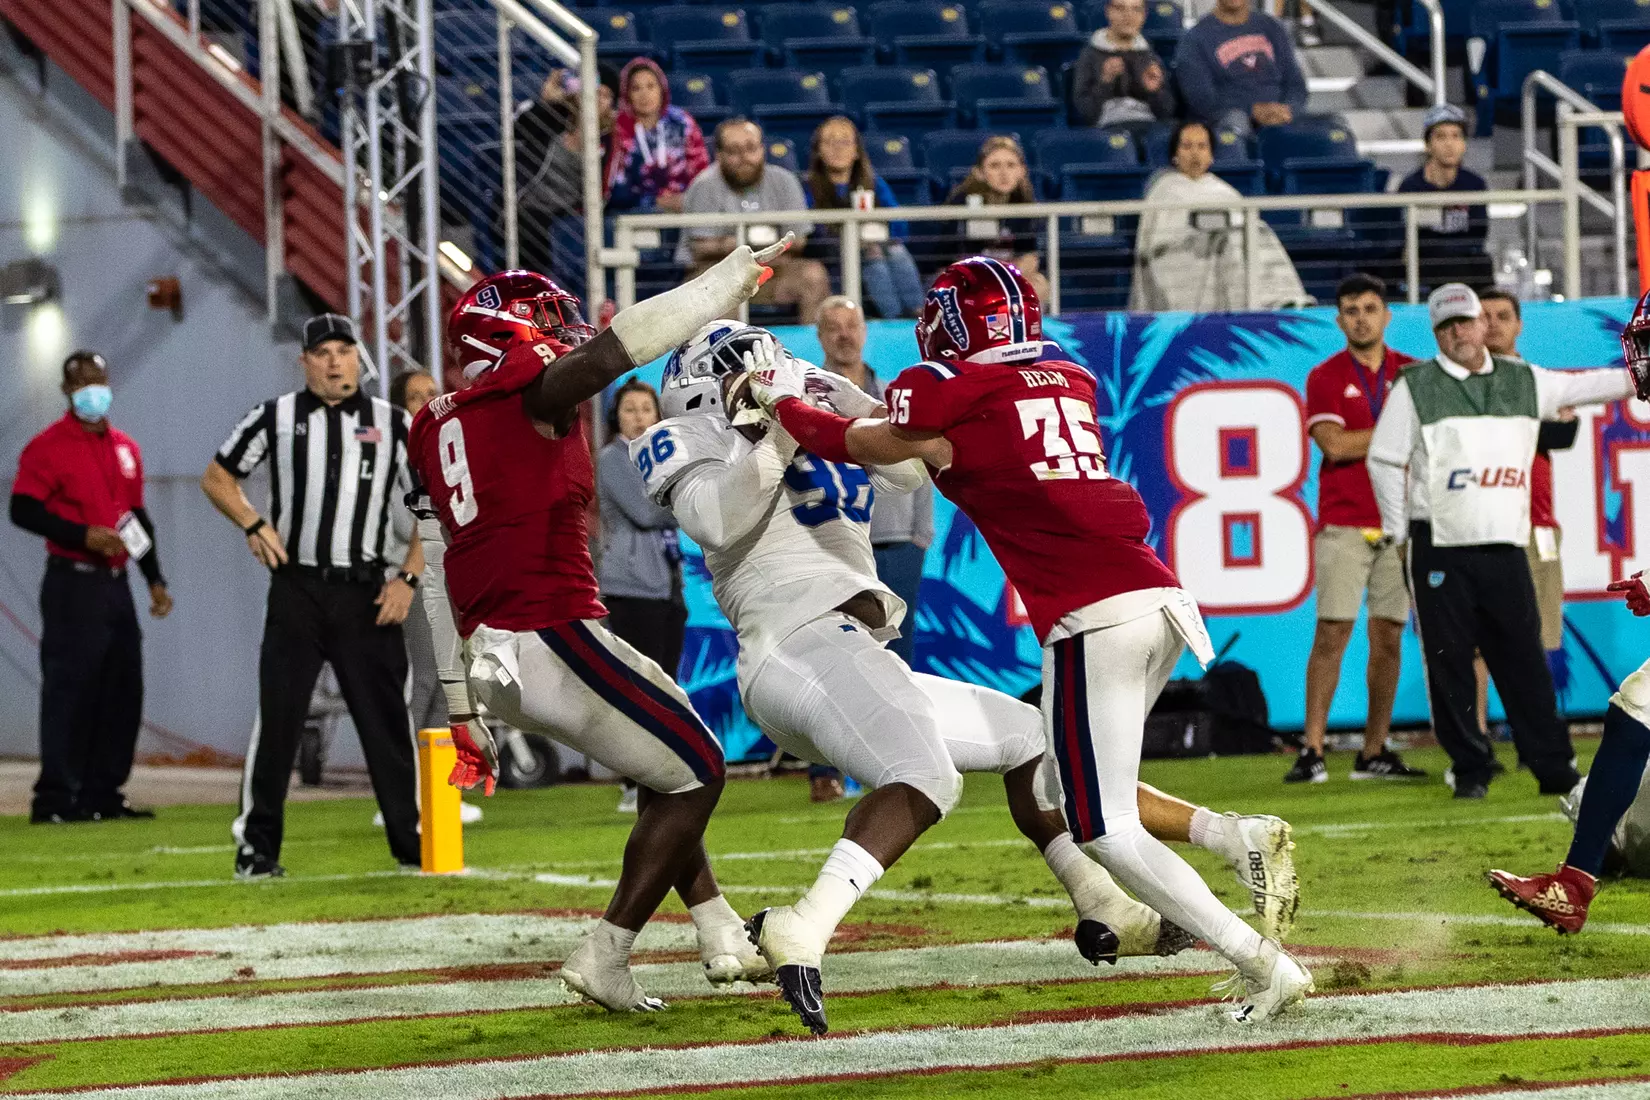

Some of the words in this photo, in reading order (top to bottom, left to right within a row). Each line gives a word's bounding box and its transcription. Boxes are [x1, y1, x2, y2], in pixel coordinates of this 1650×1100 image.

[476, 284, 502, 311] 9
[942, 293, 967, 345] ATLANTIC
[533, 343, 557, 366] 9
[1018, 370, 1070, 388] HELM
[889, 388, 913, 424] 35
[1014, 397, 1112, 481] 35
[360, 459, 373, 480] L
[636, 428, 676, 482] 96
[438, 417, 479, 528] 9
[1530, 892, 1576, 914] adidas
